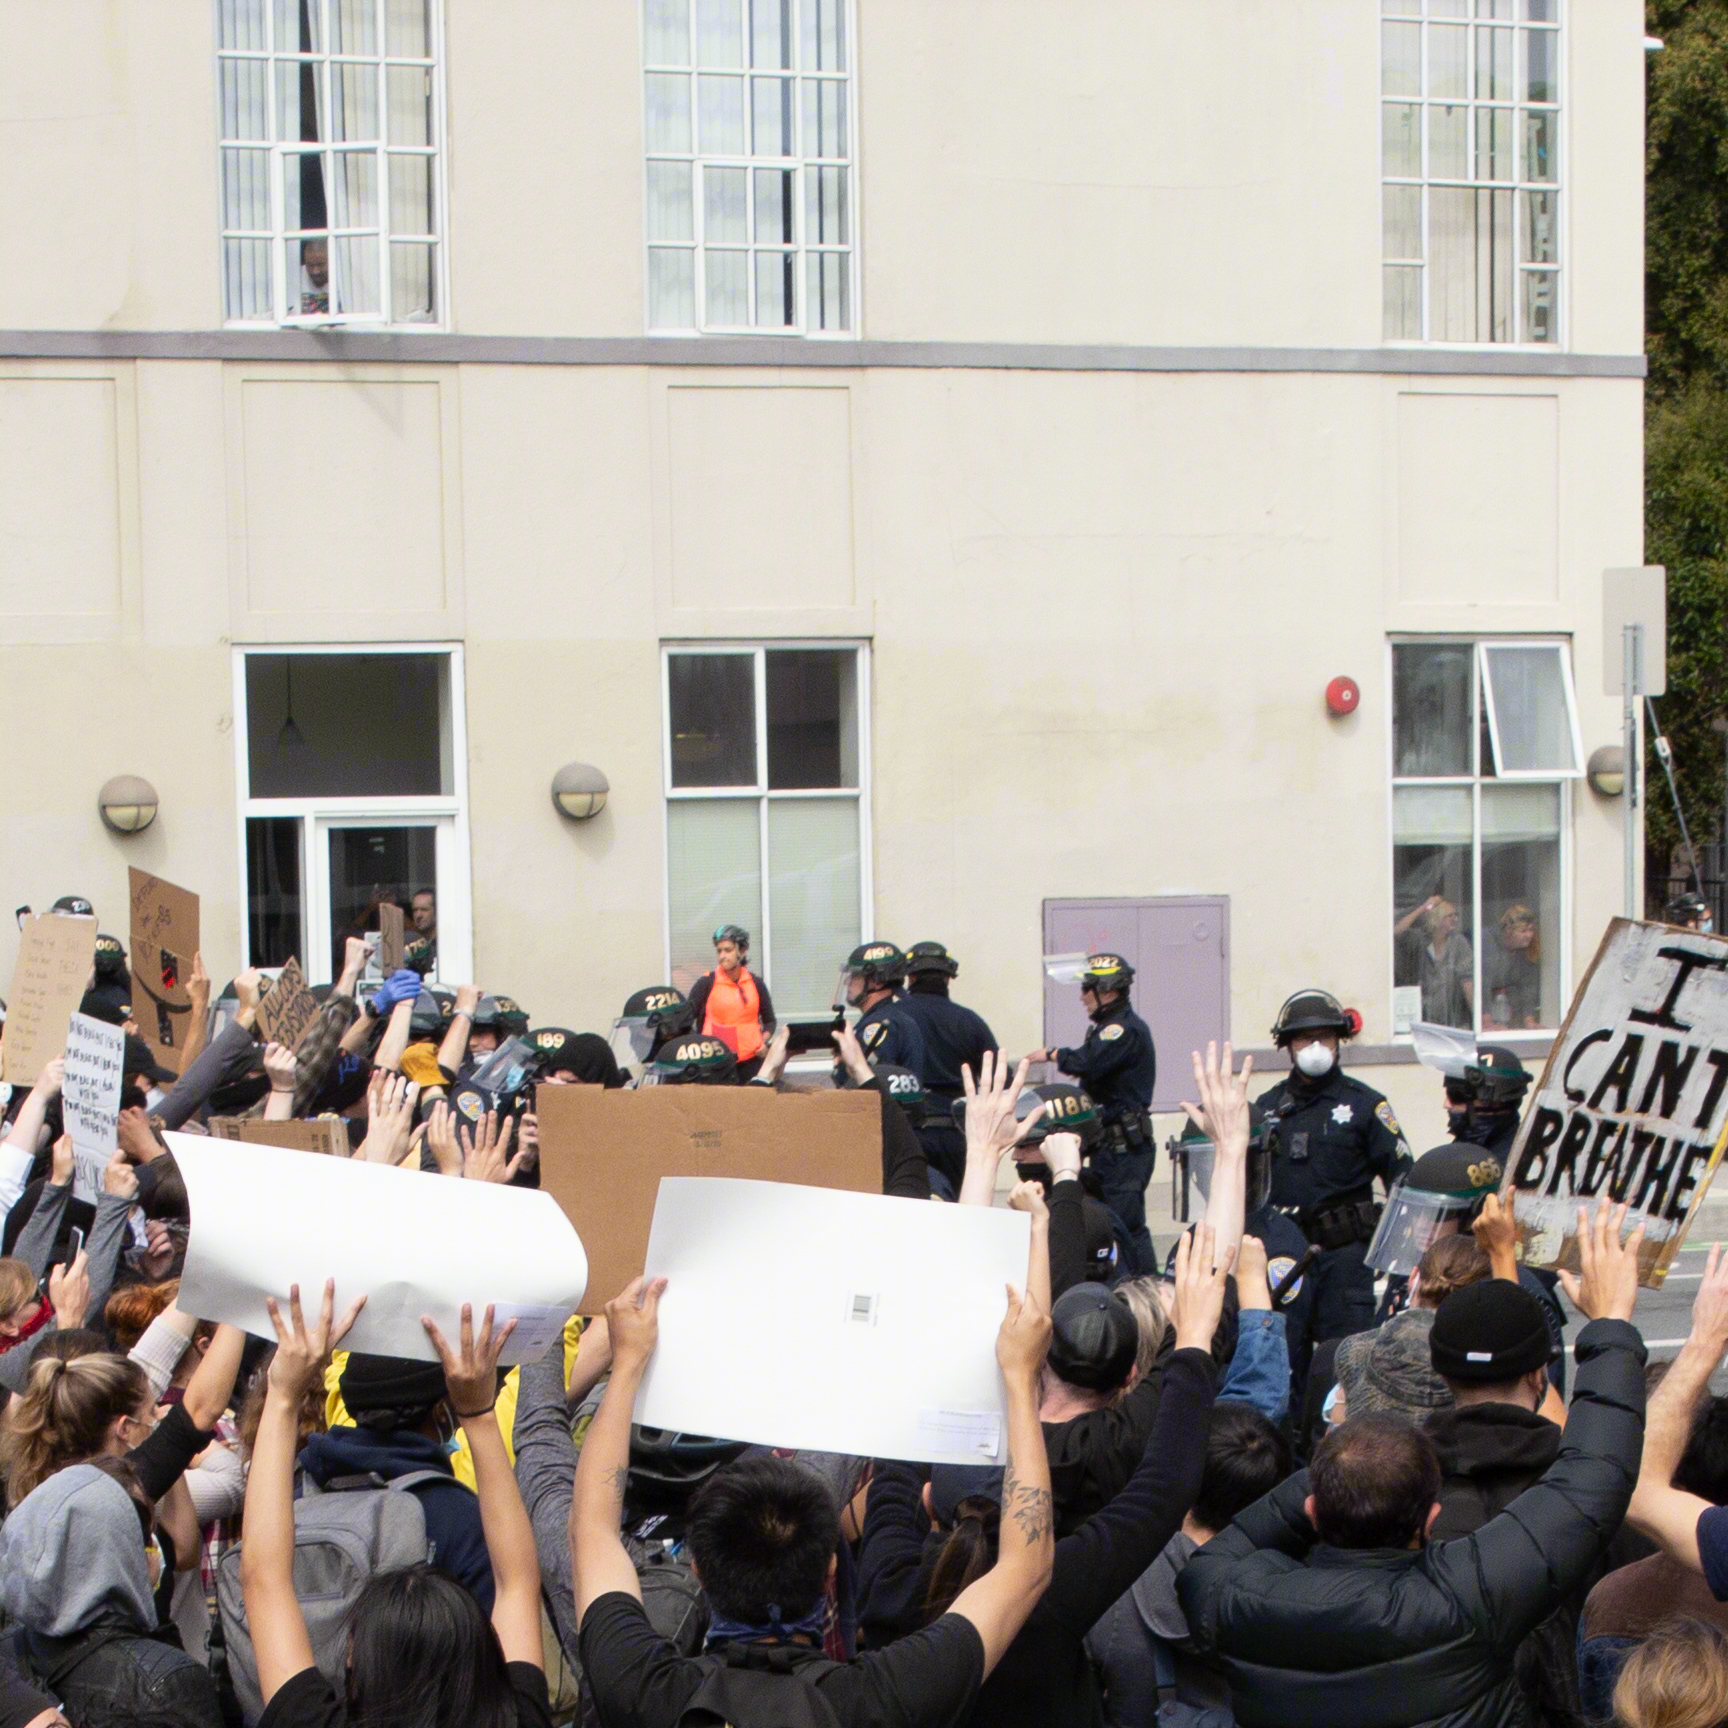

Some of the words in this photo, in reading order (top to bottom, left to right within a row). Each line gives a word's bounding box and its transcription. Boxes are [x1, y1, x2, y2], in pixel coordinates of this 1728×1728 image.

[675, 1040, 725, 1062] 4095
[887, 1074, 921, 1095] 283
[1515, 1105, 1722, 1224] BREATHE
